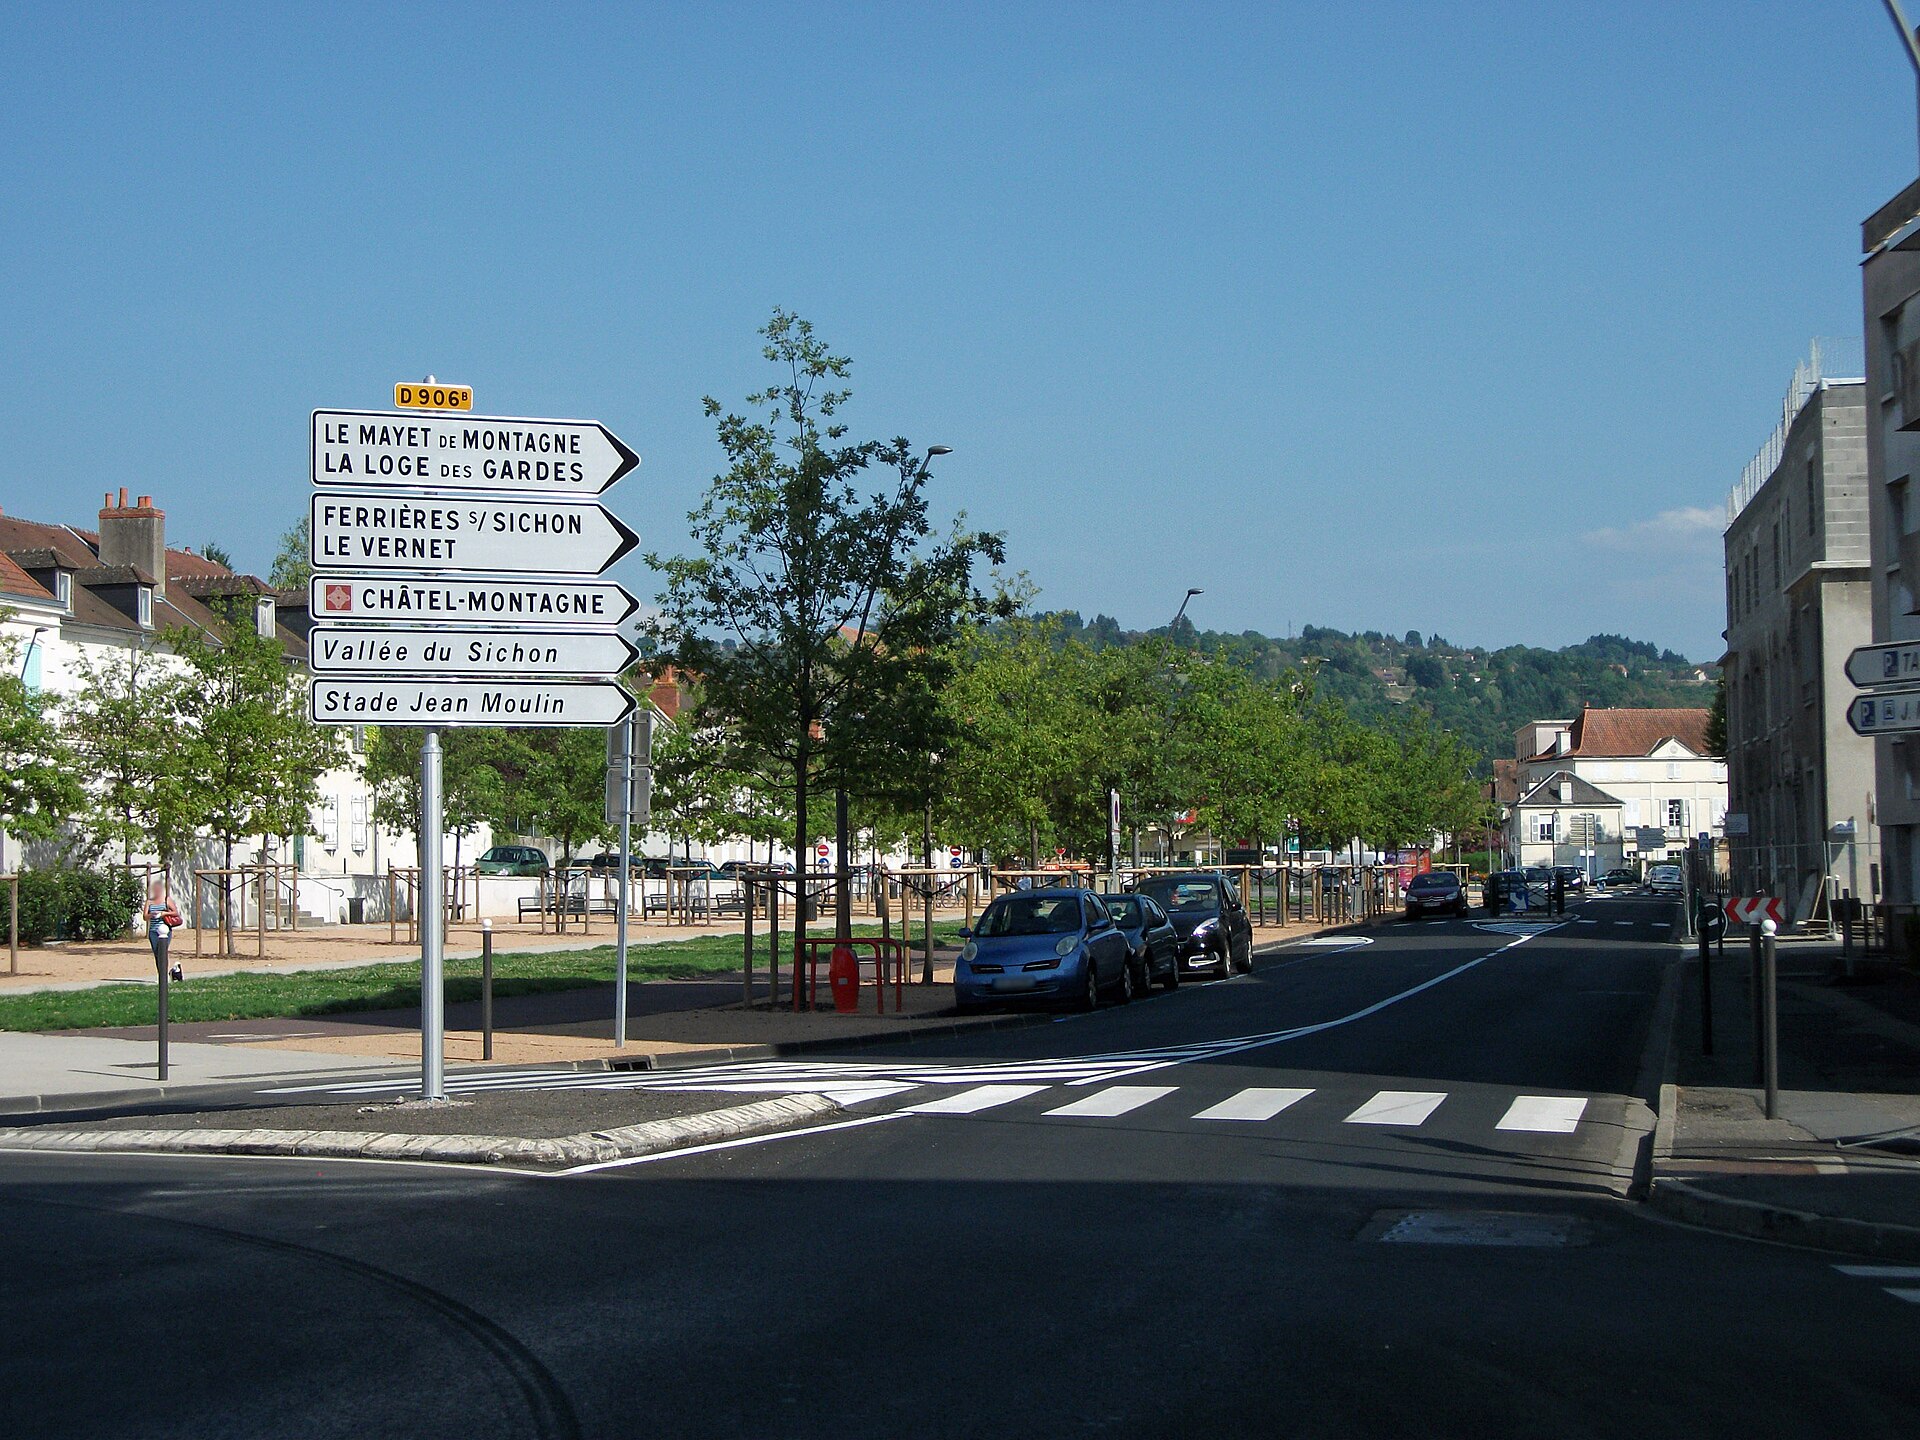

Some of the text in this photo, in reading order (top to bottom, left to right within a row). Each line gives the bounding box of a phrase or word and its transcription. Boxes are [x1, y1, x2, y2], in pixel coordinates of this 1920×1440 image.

[400, 387, 412, 404] D
[324, 423, 582, 455] LE MAYET DE MONTAGNE
[324, 452, 585, 483] LA LOGE DES GARDES
[324, 503, 461, 531] FERRIÈRES
[324, 535, 457, 560] LE VERNET
[362, 584, 605, 614] CHÂTEL-MONTAGNE
[324, 639, 559, 664] Vallée du Sichon
[324, 690, 565, 714] Stade Jean Moulin
